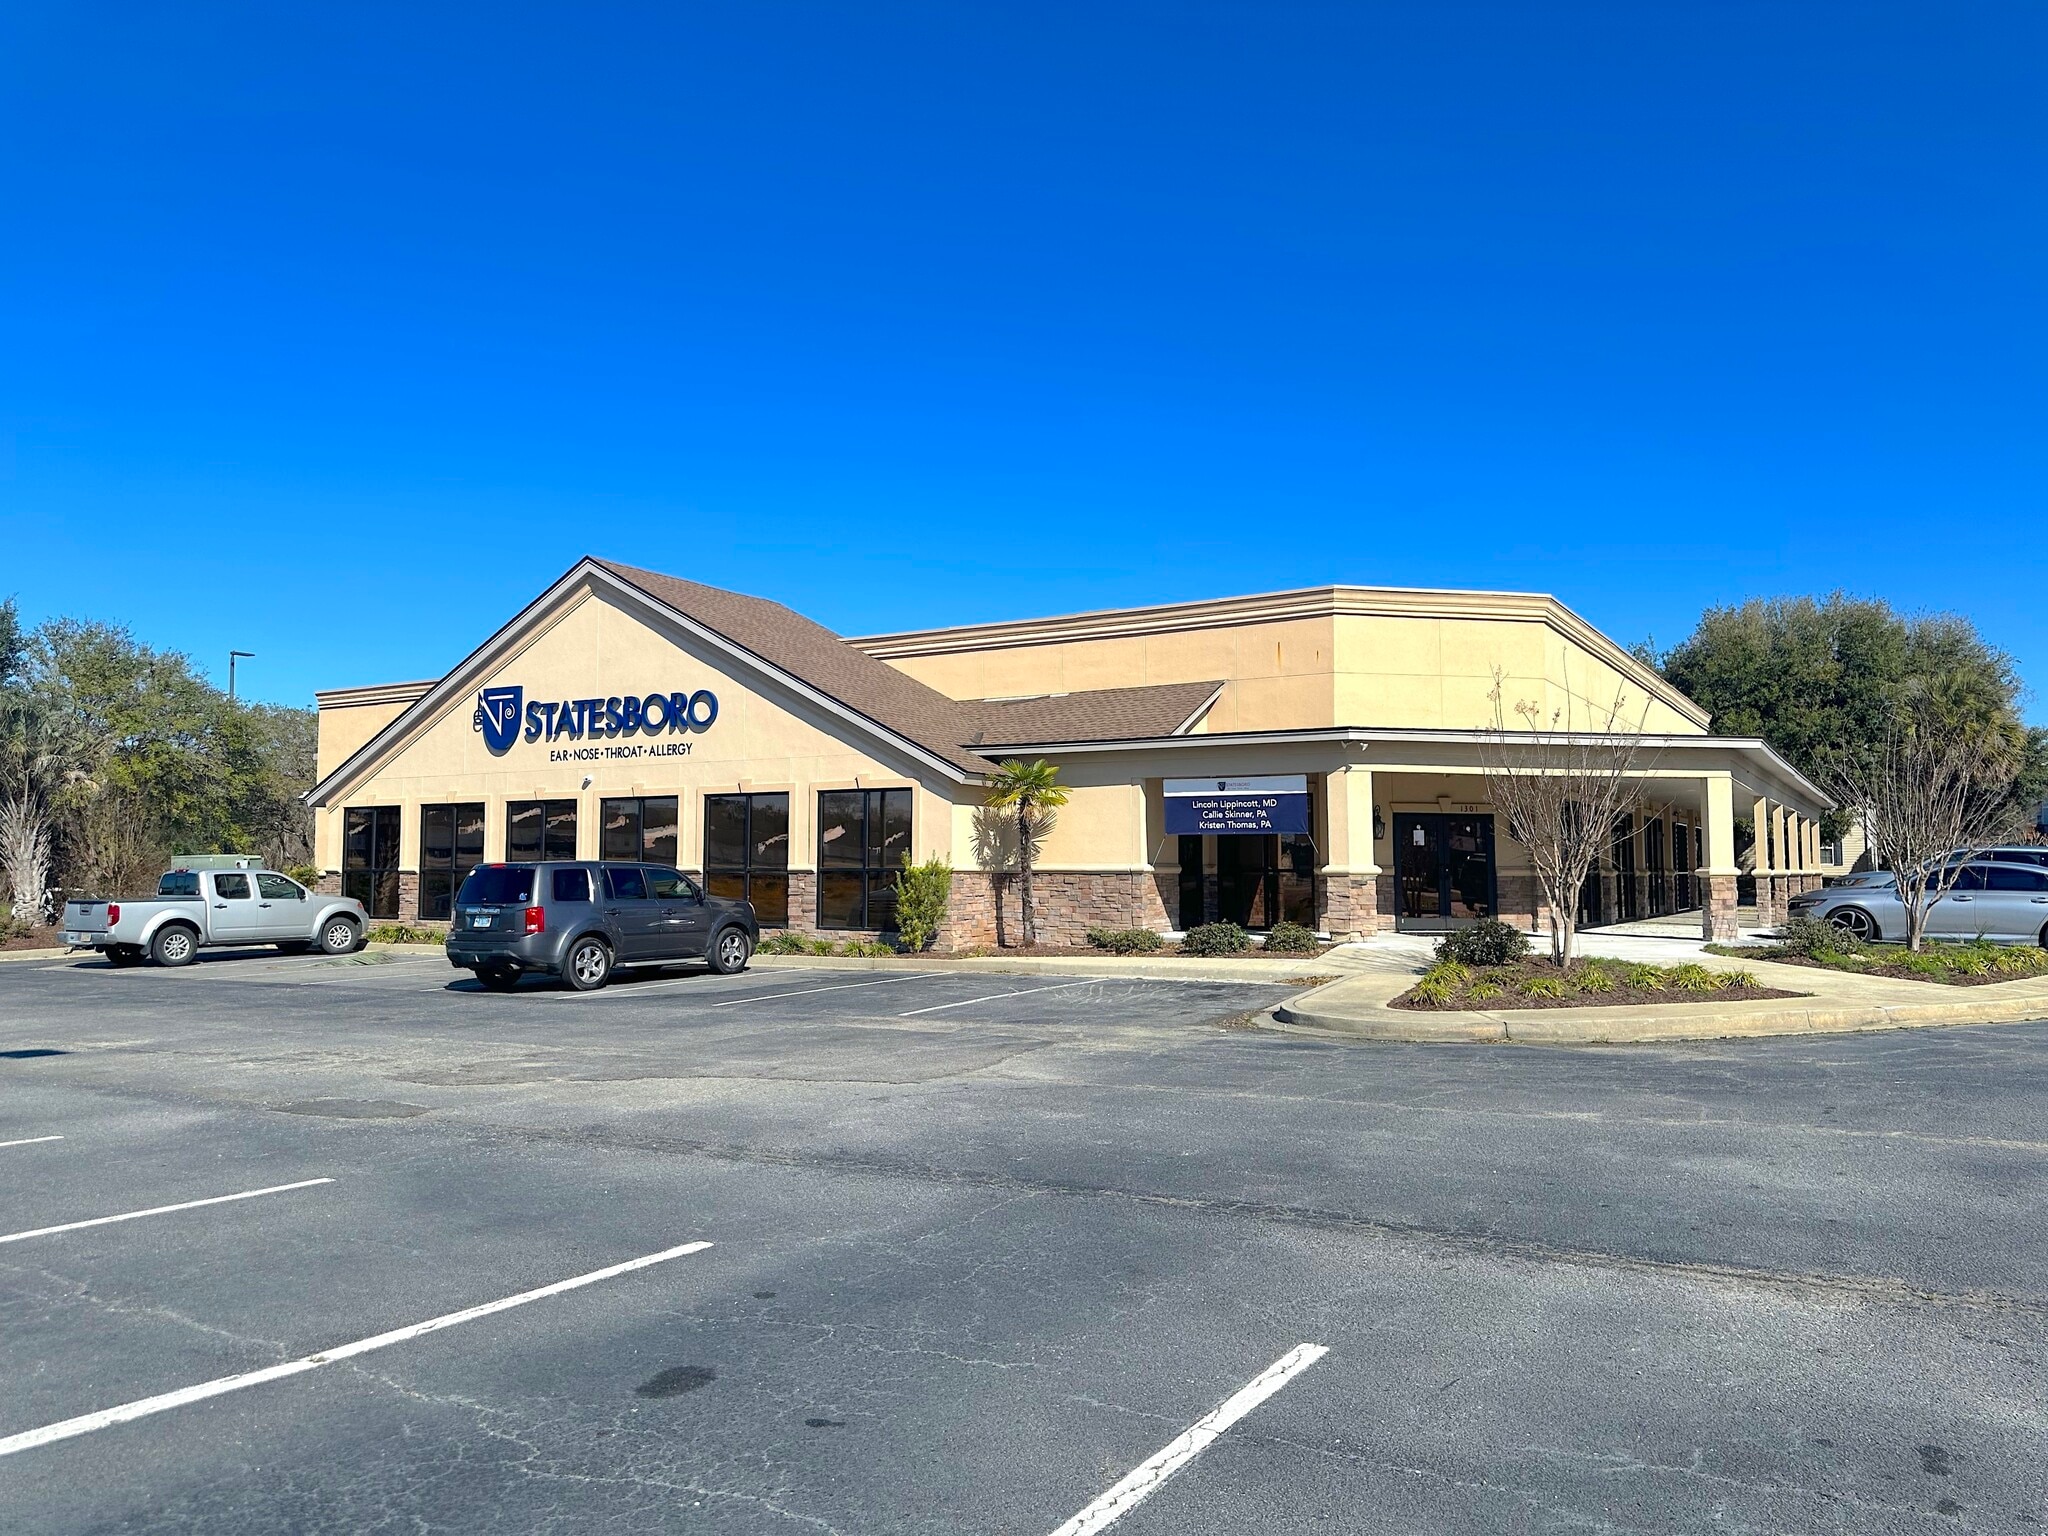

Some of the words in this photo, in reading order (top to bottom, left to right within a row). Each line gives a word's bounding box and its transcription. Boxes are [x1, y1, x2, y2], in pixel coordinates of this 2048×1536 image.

[524, 690, 719, 742] STATESBORO
[649, 743, 693, 757] ALLERGY
[1192, 800, 1218, 808] Lincoln
[1220, 800, 1261, 810] Lippincott,
[1262, 799, 1277, 807] MD
[1202, 810, 1223, 819] Callie
[1225, 810, 1255, 819] Skinner,
[1256, 810, 1267, 818] PA
[1199, 821, 1225, 829] Kristen
[1227, 820, 1259, 829] Thomas,
[1260, 820, 1272, 828] PA
